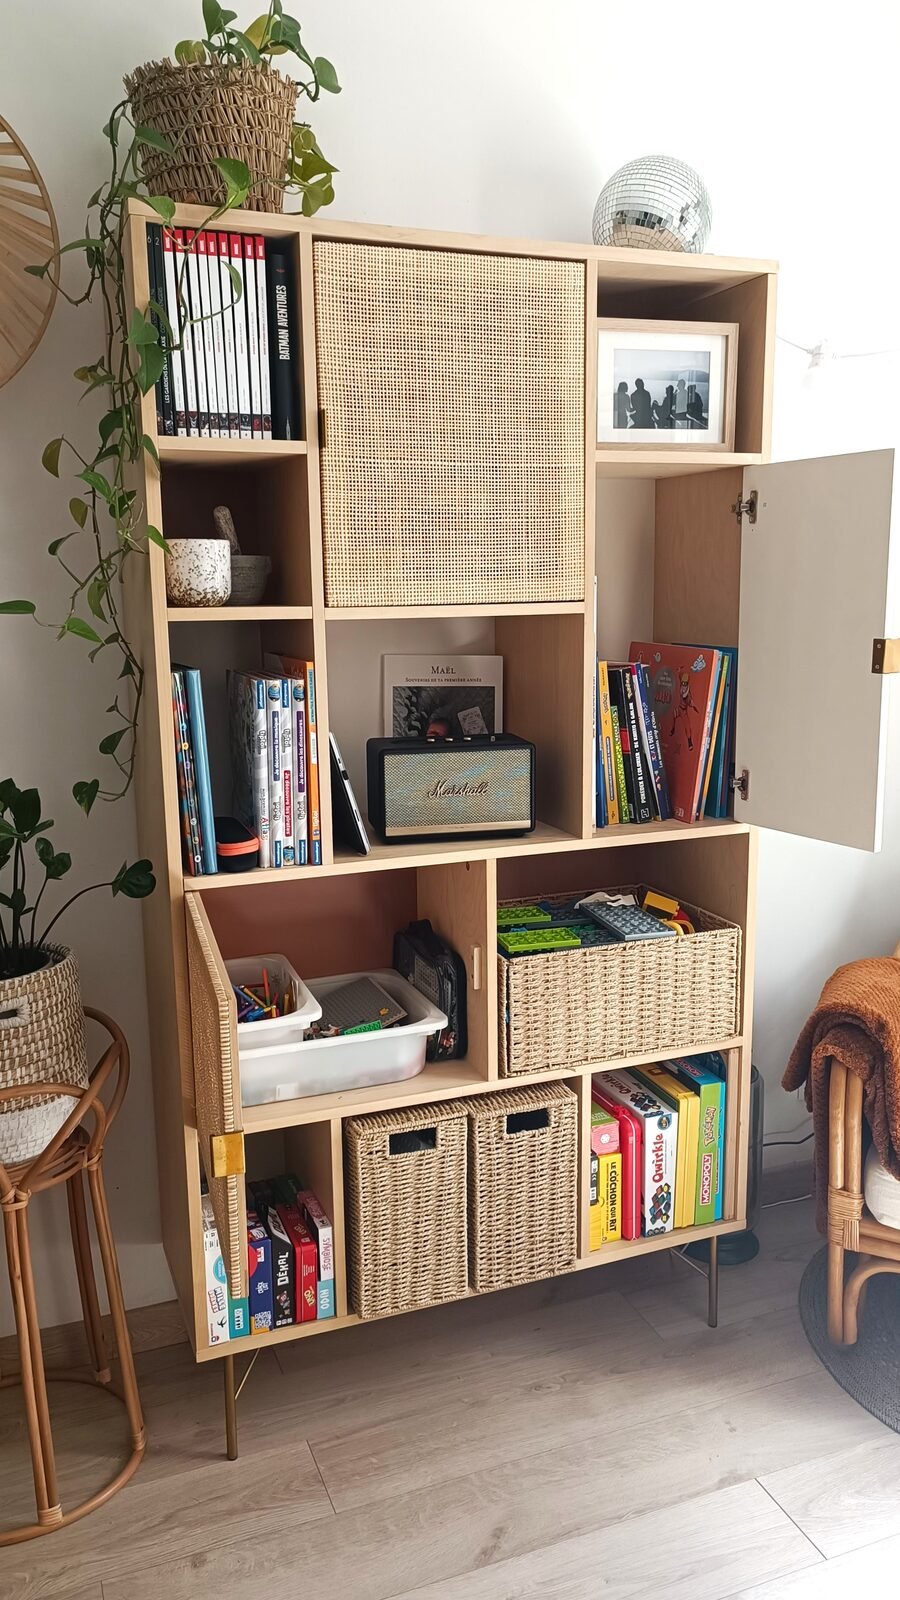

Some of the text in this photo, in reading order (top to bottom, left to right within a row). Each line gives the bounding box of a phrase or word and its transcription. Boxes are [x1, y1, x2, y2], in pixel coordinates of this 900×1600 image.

[276, 284, 291, 361] BATMAN AVENTURES
[428, 779, 490, 799] Marshall
[260, 817, 268, 841] Atlas
[610, 1162, 616, 1170] LE
[652, 1134, 664, 1184] Qwirkle
[610, 1170, 619, 1207] COCHON
[701, 1154, 712, 1204] MONOPOLY
[277, 1252, 289, 1286] DÉKAL
[320, 1238, 332, 1271] SYMBIOSE
[214, 1286, 226, 1311] MILLE
